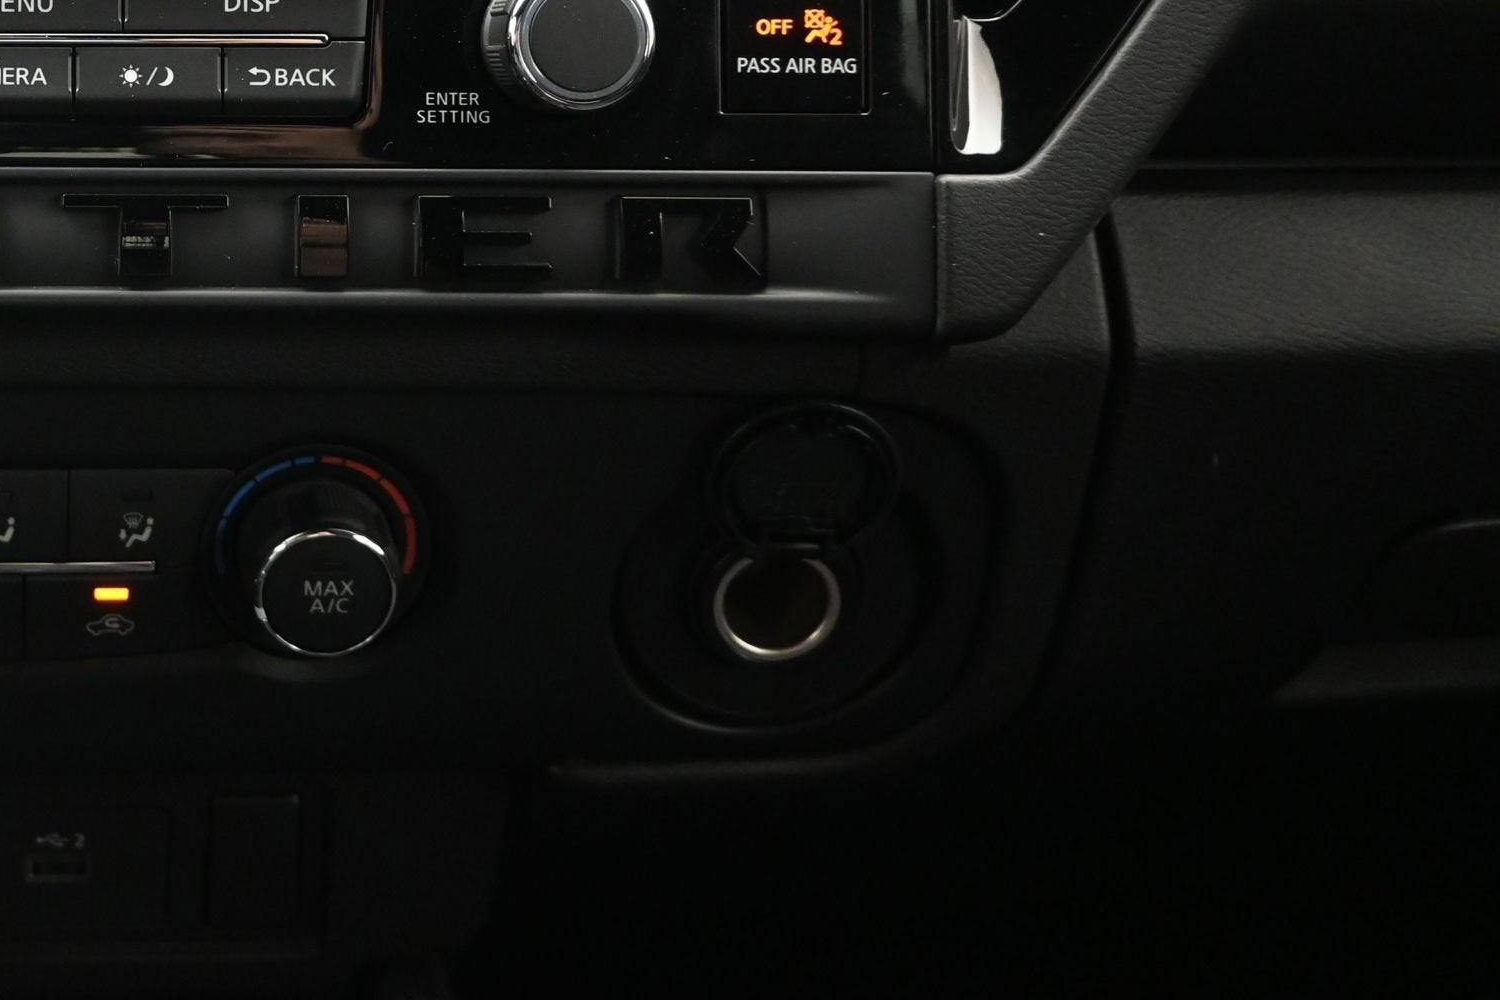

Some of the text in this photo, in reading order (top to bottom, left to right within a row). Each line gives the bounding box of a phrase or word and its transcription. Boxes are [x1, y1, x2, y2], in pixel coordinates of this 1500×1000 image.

[755, 18, 794, 36] OFF
[736, 57, 857, 74] PASS AIR BAG
[274, 67, 336, 87] BACK
[425, 92, 479, 106] ENTER
[416, 109, 490, 124] SETTING
[304, 579, 354, 597] MAX
[309, 598, 349, 614] A/C
